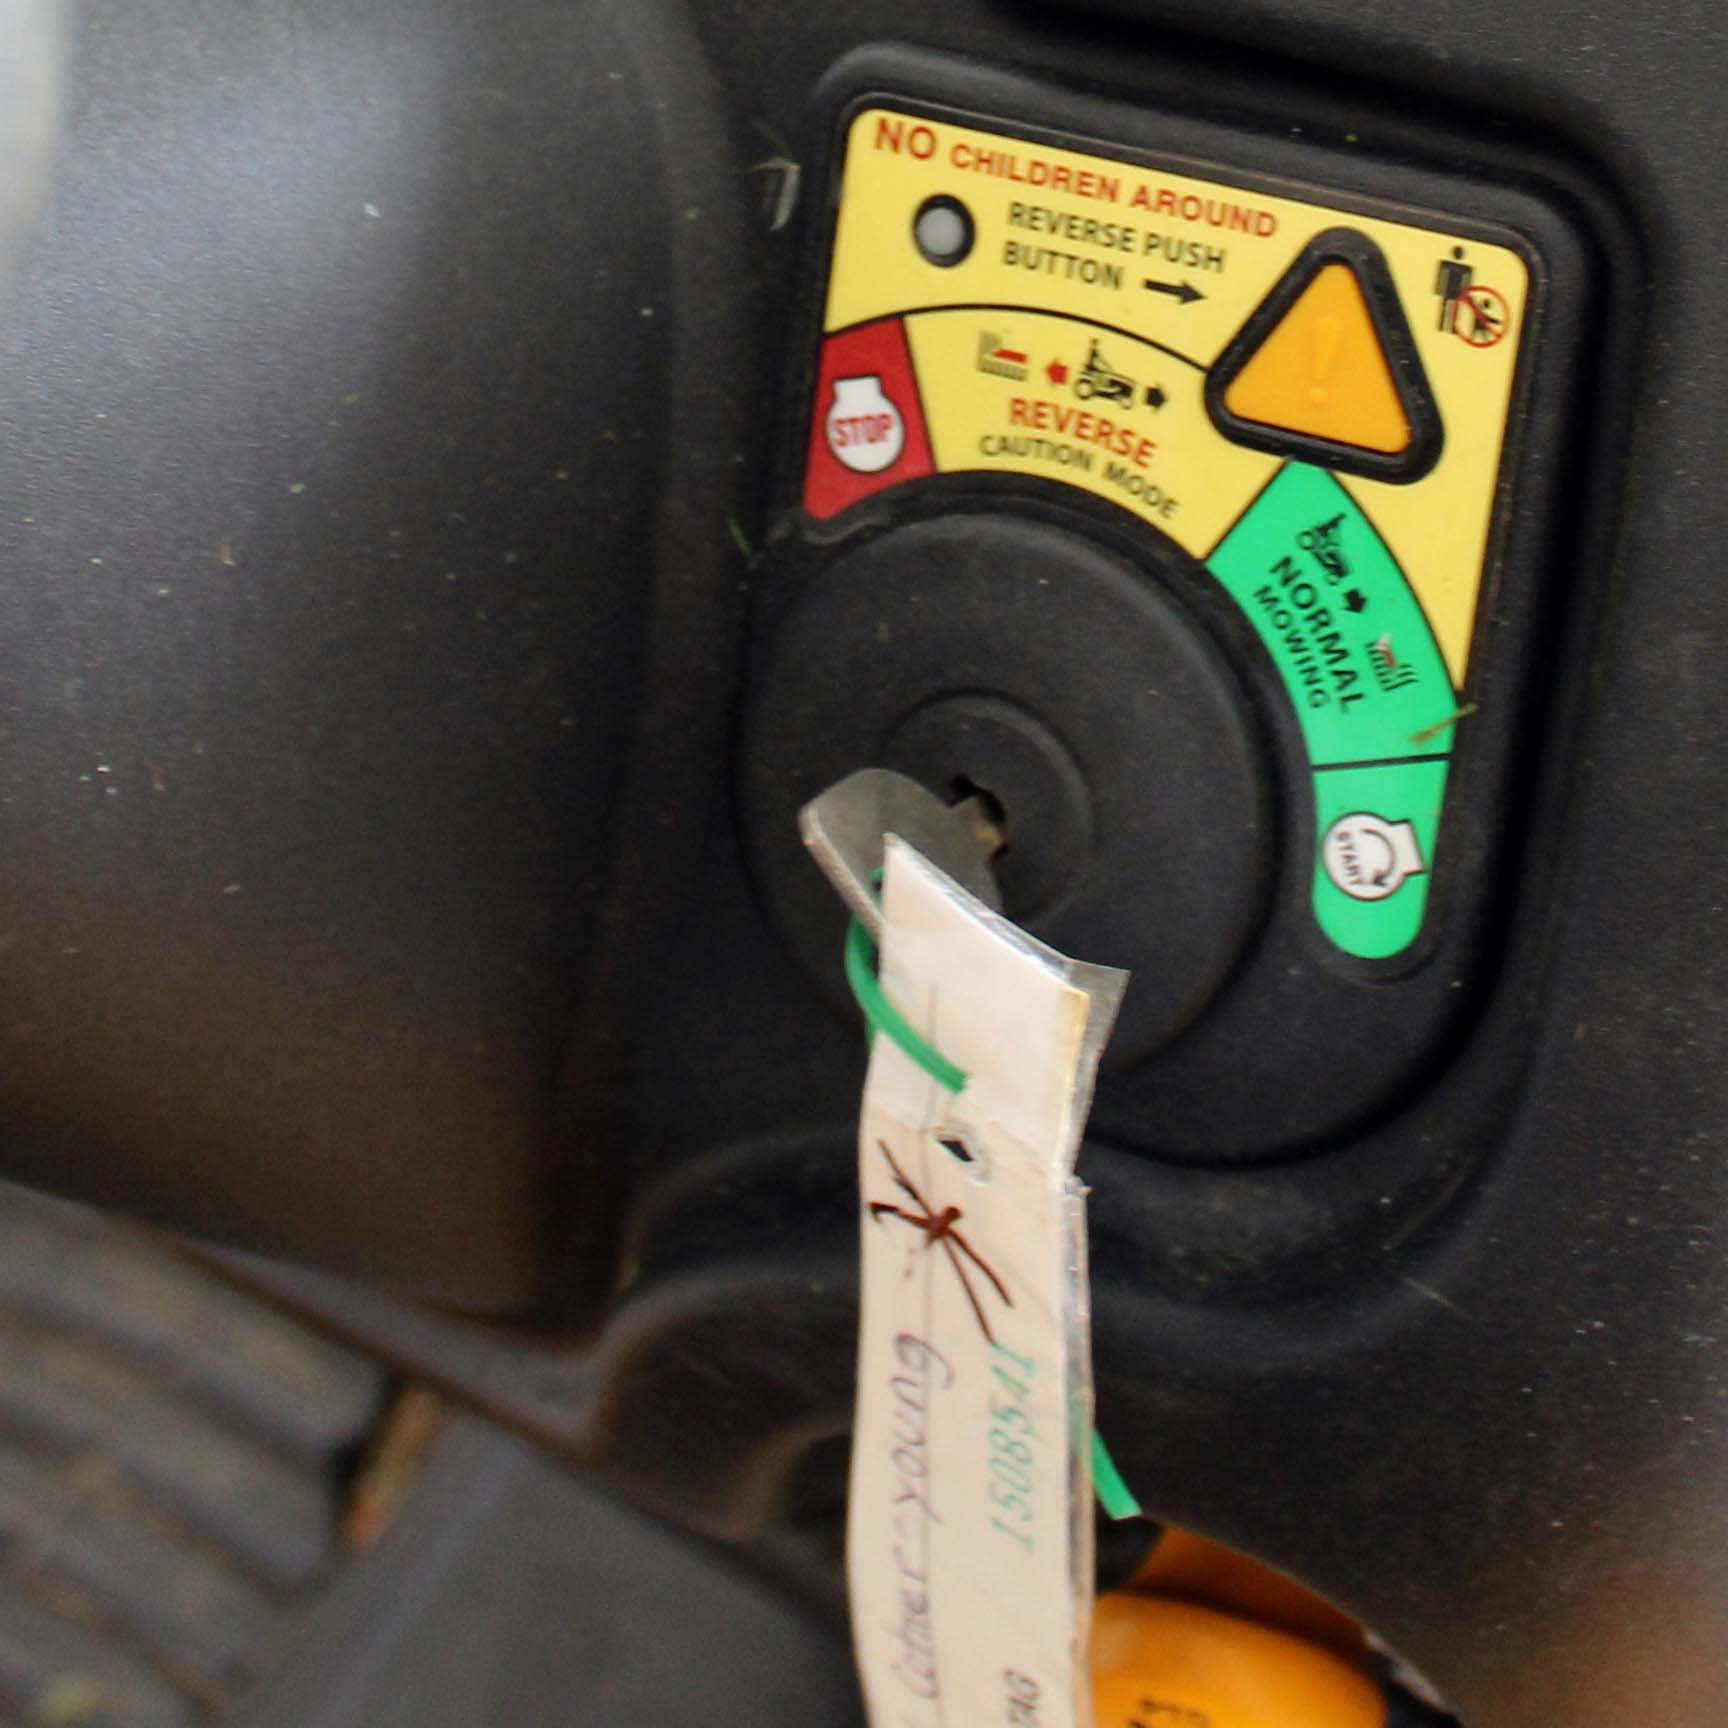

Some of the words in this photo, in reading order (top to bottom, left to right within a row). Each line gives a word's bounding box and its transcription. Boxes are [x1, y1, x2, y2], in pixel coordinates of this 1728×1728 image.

[873, 117, 936, 159] NO
[951, 143, 1120, 203] CHILDREN
[1129, 184, 1278, 239] AROUND
[1003, 241, 1124, 290] BUTTON
[1007, 201, 1135, 253] REVERSE
[1143, 233, 1226, 273] PUSH
[833, 411, 893, 448] STOP
[1010, 398, 1157, 468] REVERSE
[979, 434, 1095, 473] CAUTION
[1102, 461, 1179, 519] MODE
[1253, 585, 1331, 710] MOWING
[1269, 555, 1365, 714] NORMAL
[1335, 830, 1361, 885] START
[988, 1343, 1036, 1553] 1508541
